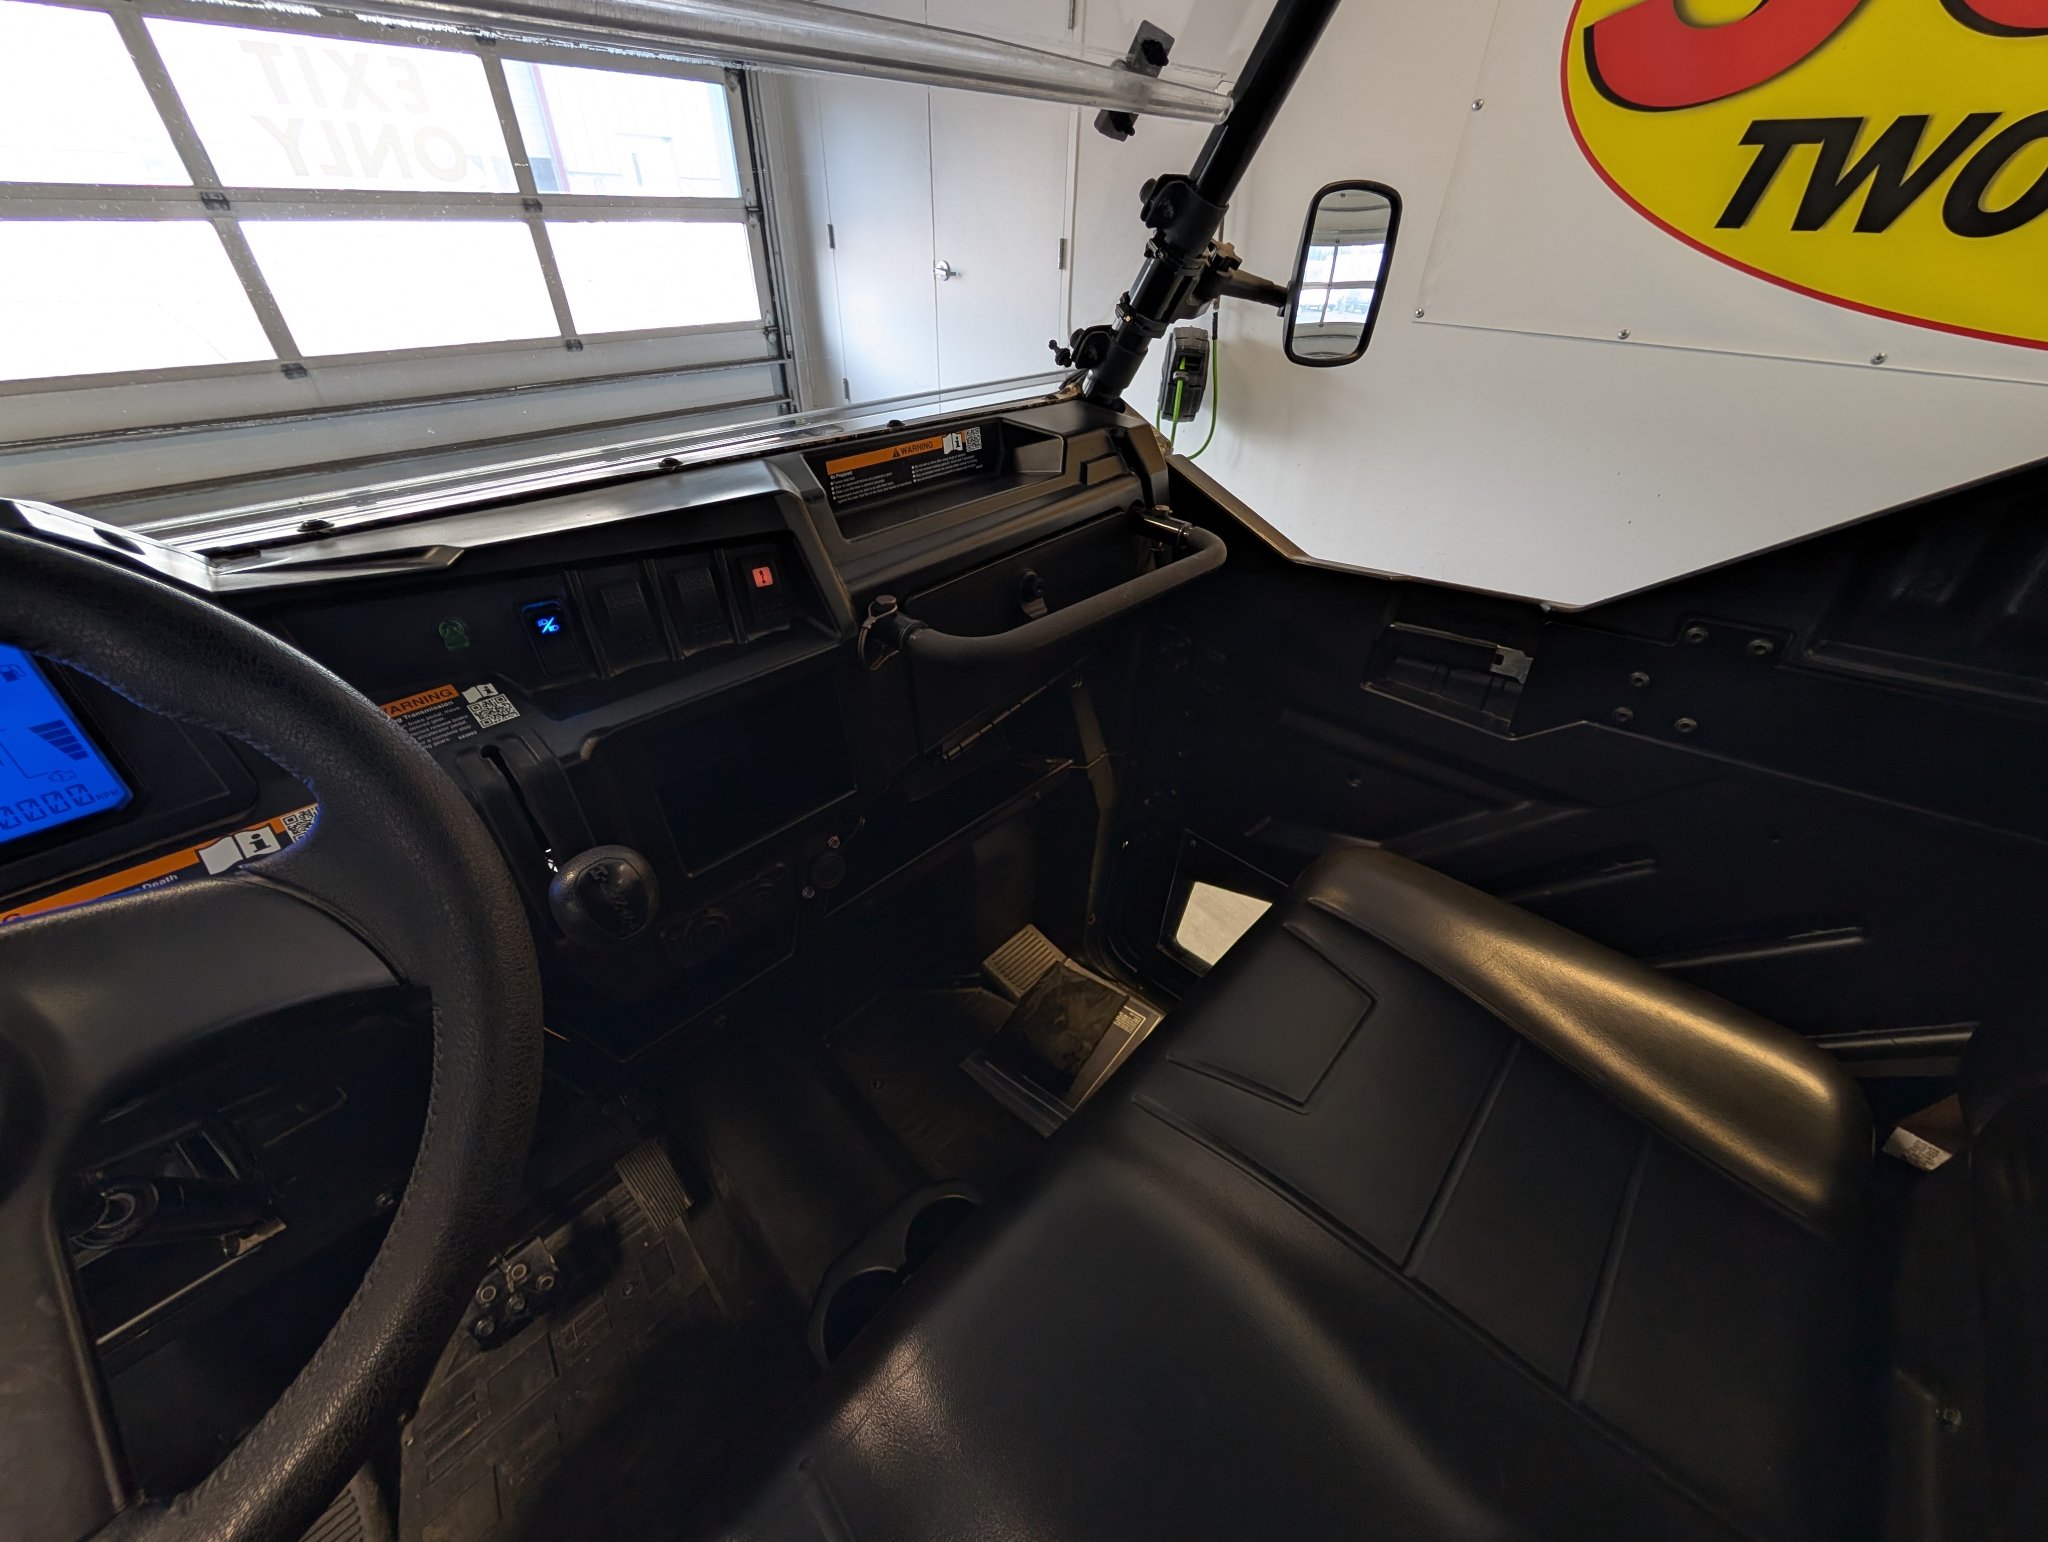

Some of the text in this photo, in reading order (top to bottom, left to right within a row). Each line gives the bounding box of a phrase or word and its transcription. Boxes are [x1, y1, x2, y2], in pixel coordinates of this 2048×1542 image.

[900, 440, 934, 455] WARNING
[382, 688, 453, 715] ARNING
[402, 700, 454, 720] Transmission
[95, 788, 120, 801] RPM
[142, 873, 179, 890] Death
